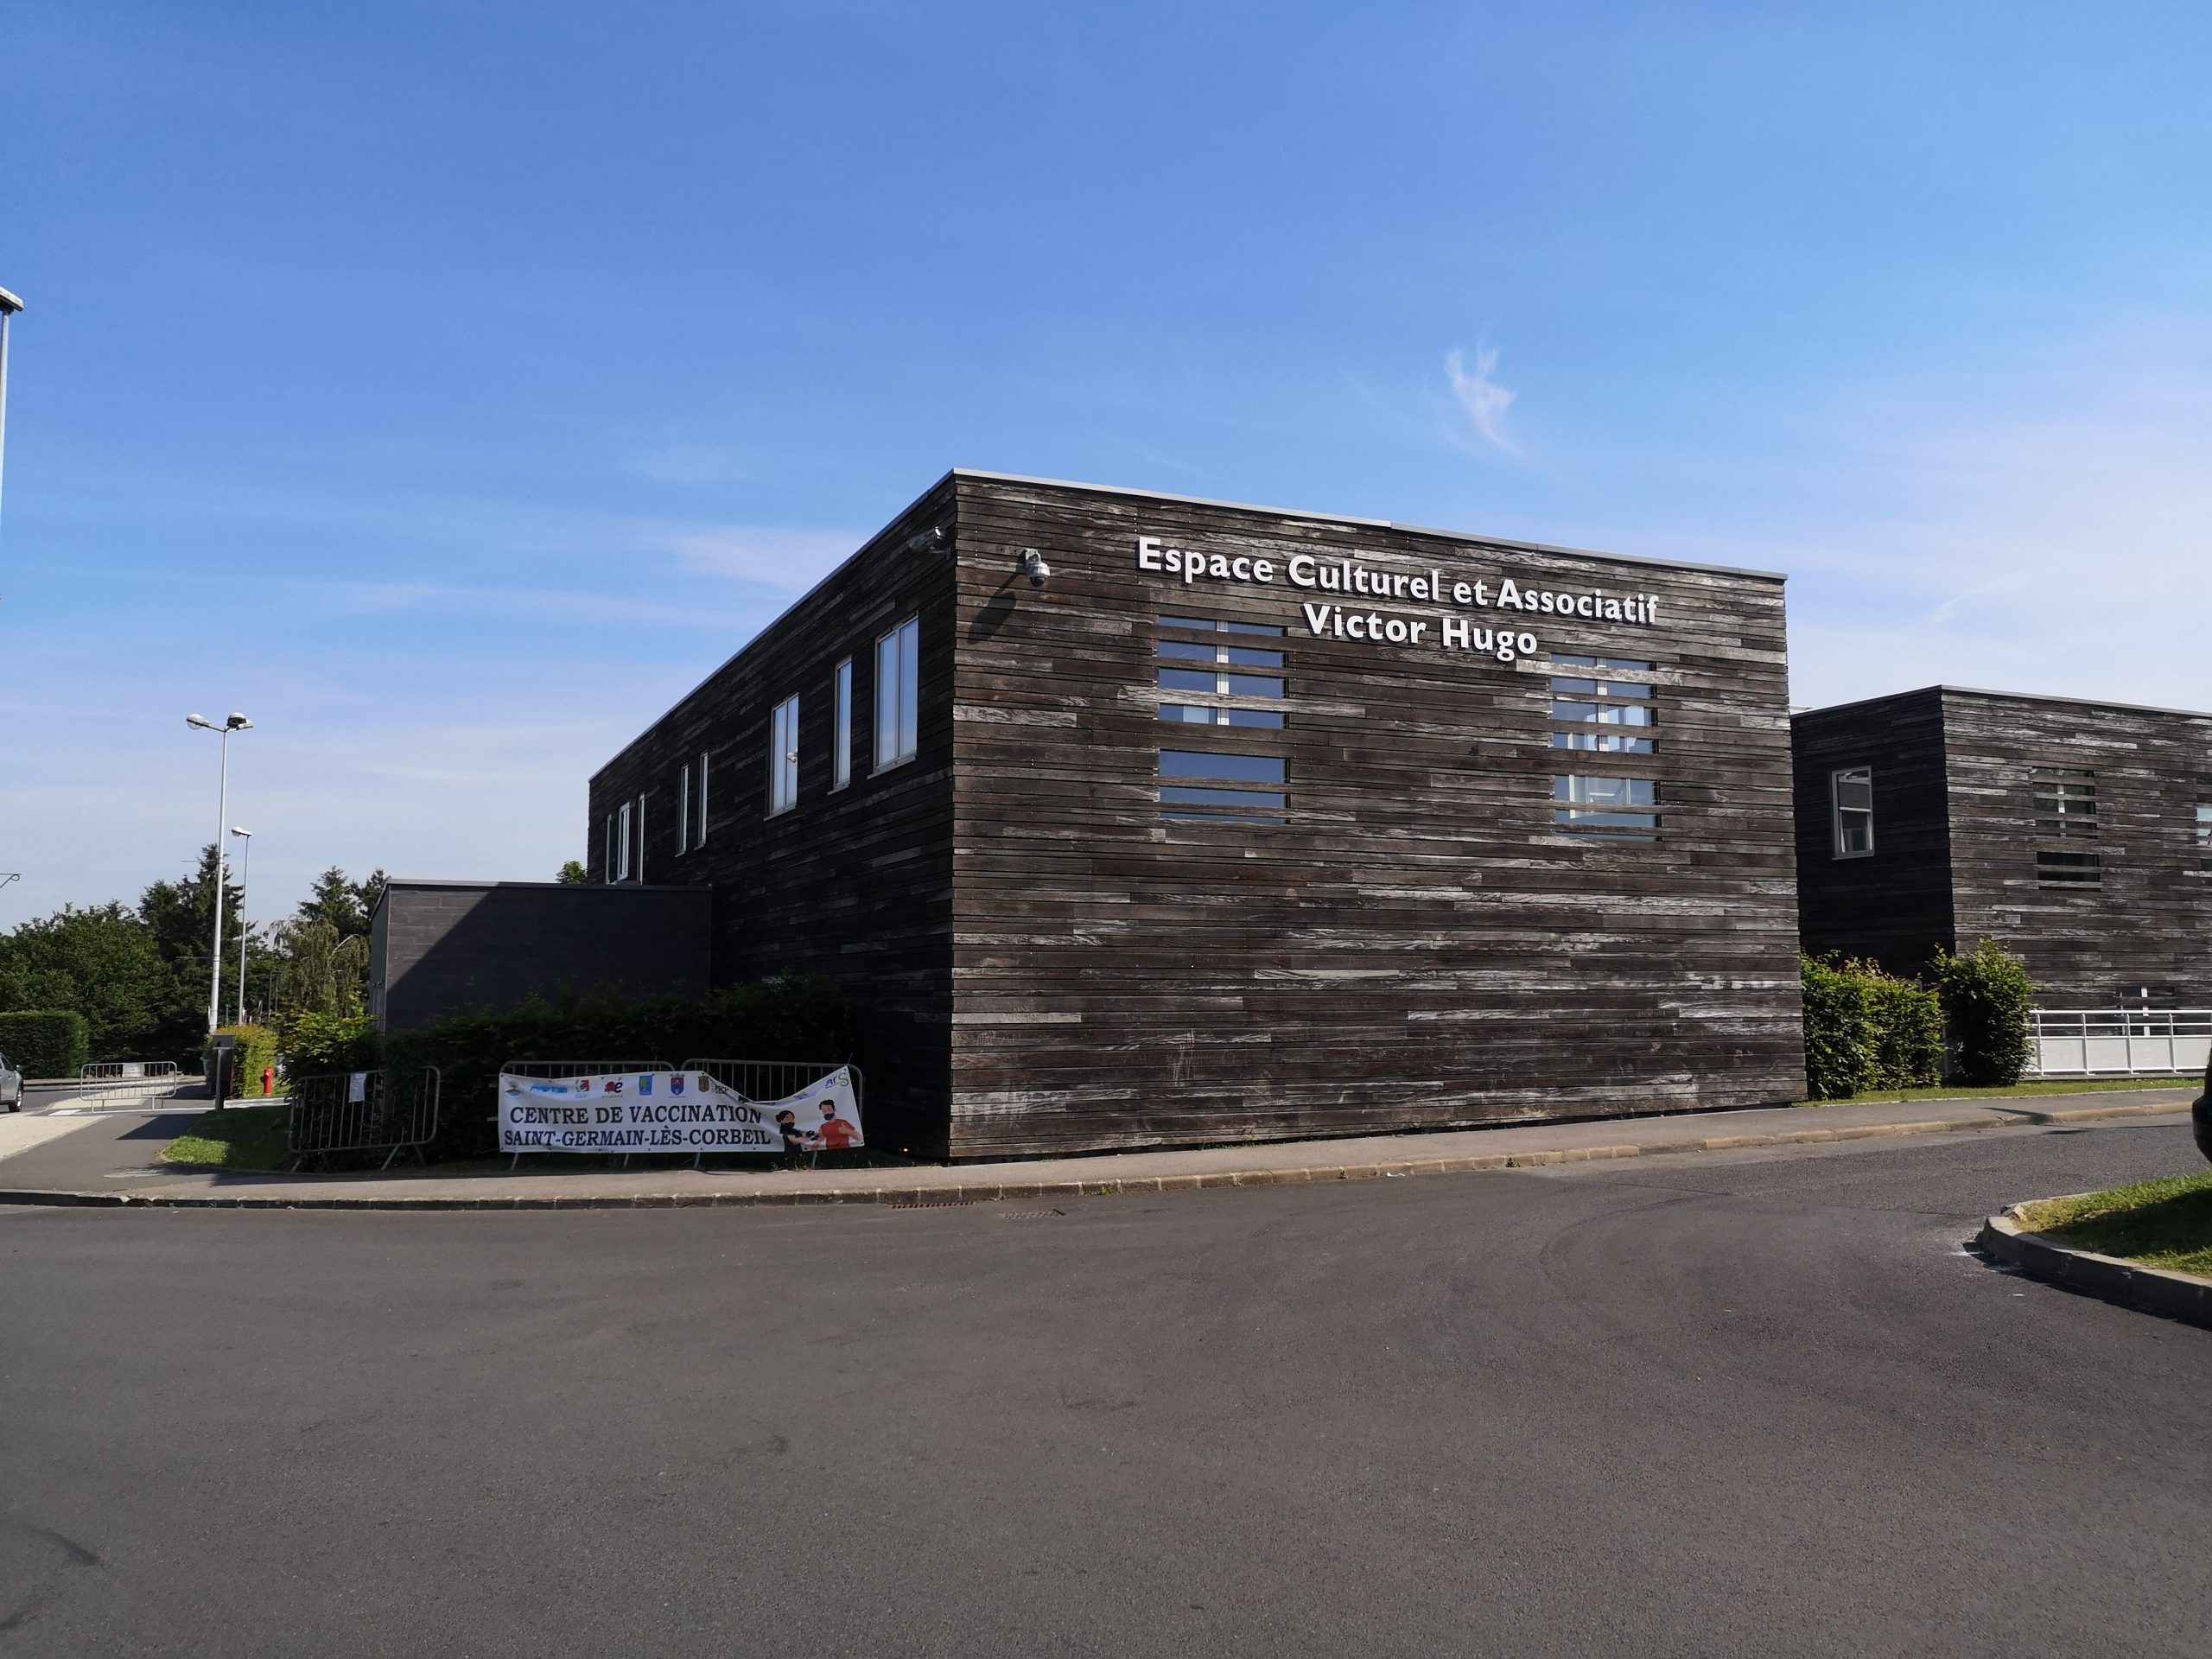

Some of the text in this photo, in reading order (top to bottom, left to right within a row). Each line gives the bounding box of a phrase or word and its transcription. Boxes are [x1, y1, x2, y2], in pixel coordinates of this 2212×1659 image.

[1138, 536, 1659, 623] Espace Culturel et Associatif
[1303, 603, 1537, 662] Victor Hugo
[510, 1104, 761, 1124] CENTRE DE VACCINATION
[504, 1124, 772, 1147] SAINT-GERMAIN-LÈS-CORBEIL
